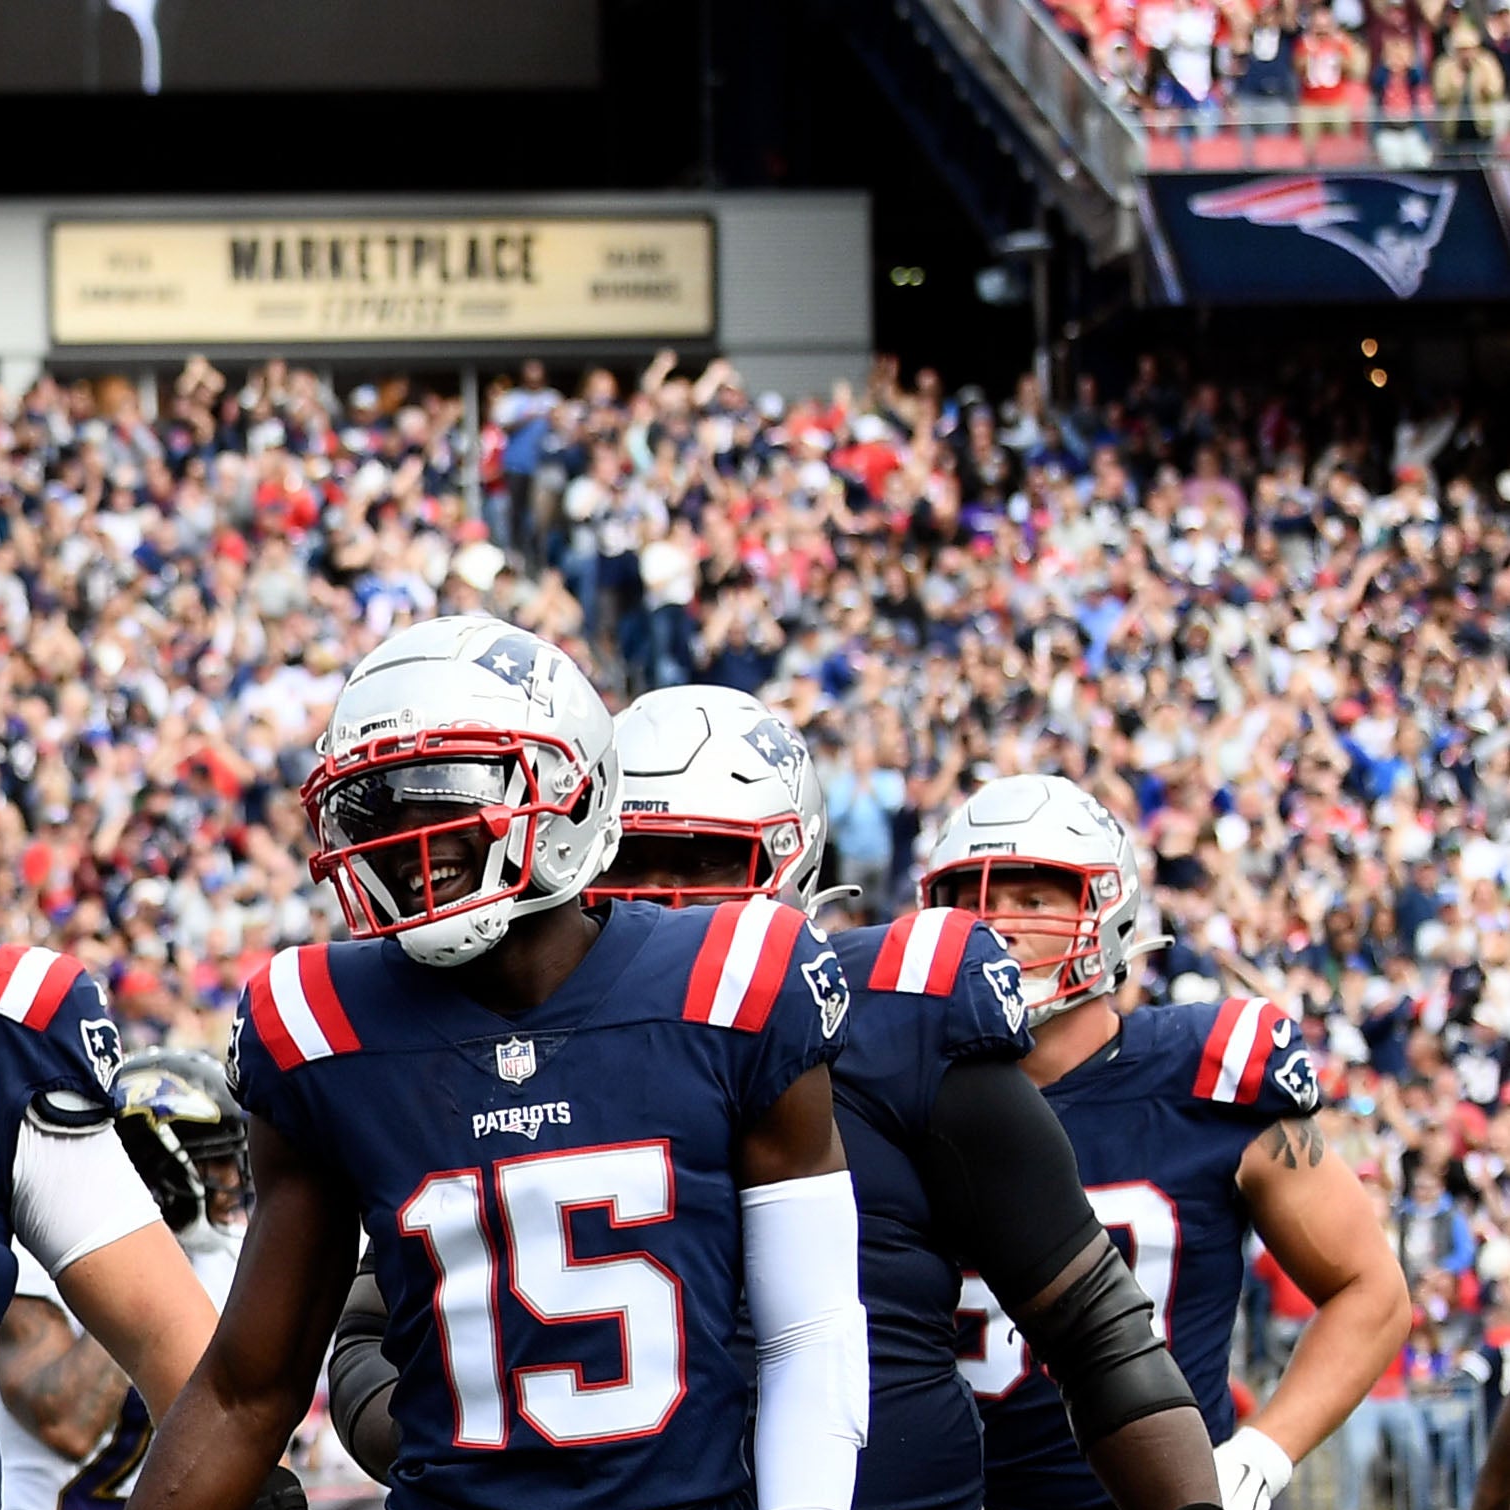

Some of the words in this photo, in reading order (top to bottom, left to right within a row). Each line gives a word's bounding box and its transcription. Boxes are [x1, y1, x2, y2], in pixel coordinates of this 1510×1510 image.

[230, 236, 539, 284] MARKETPLACE
[472, 1101, 572, 1139] PATRIOTS
[395, 1138, 689, 1450] 15
